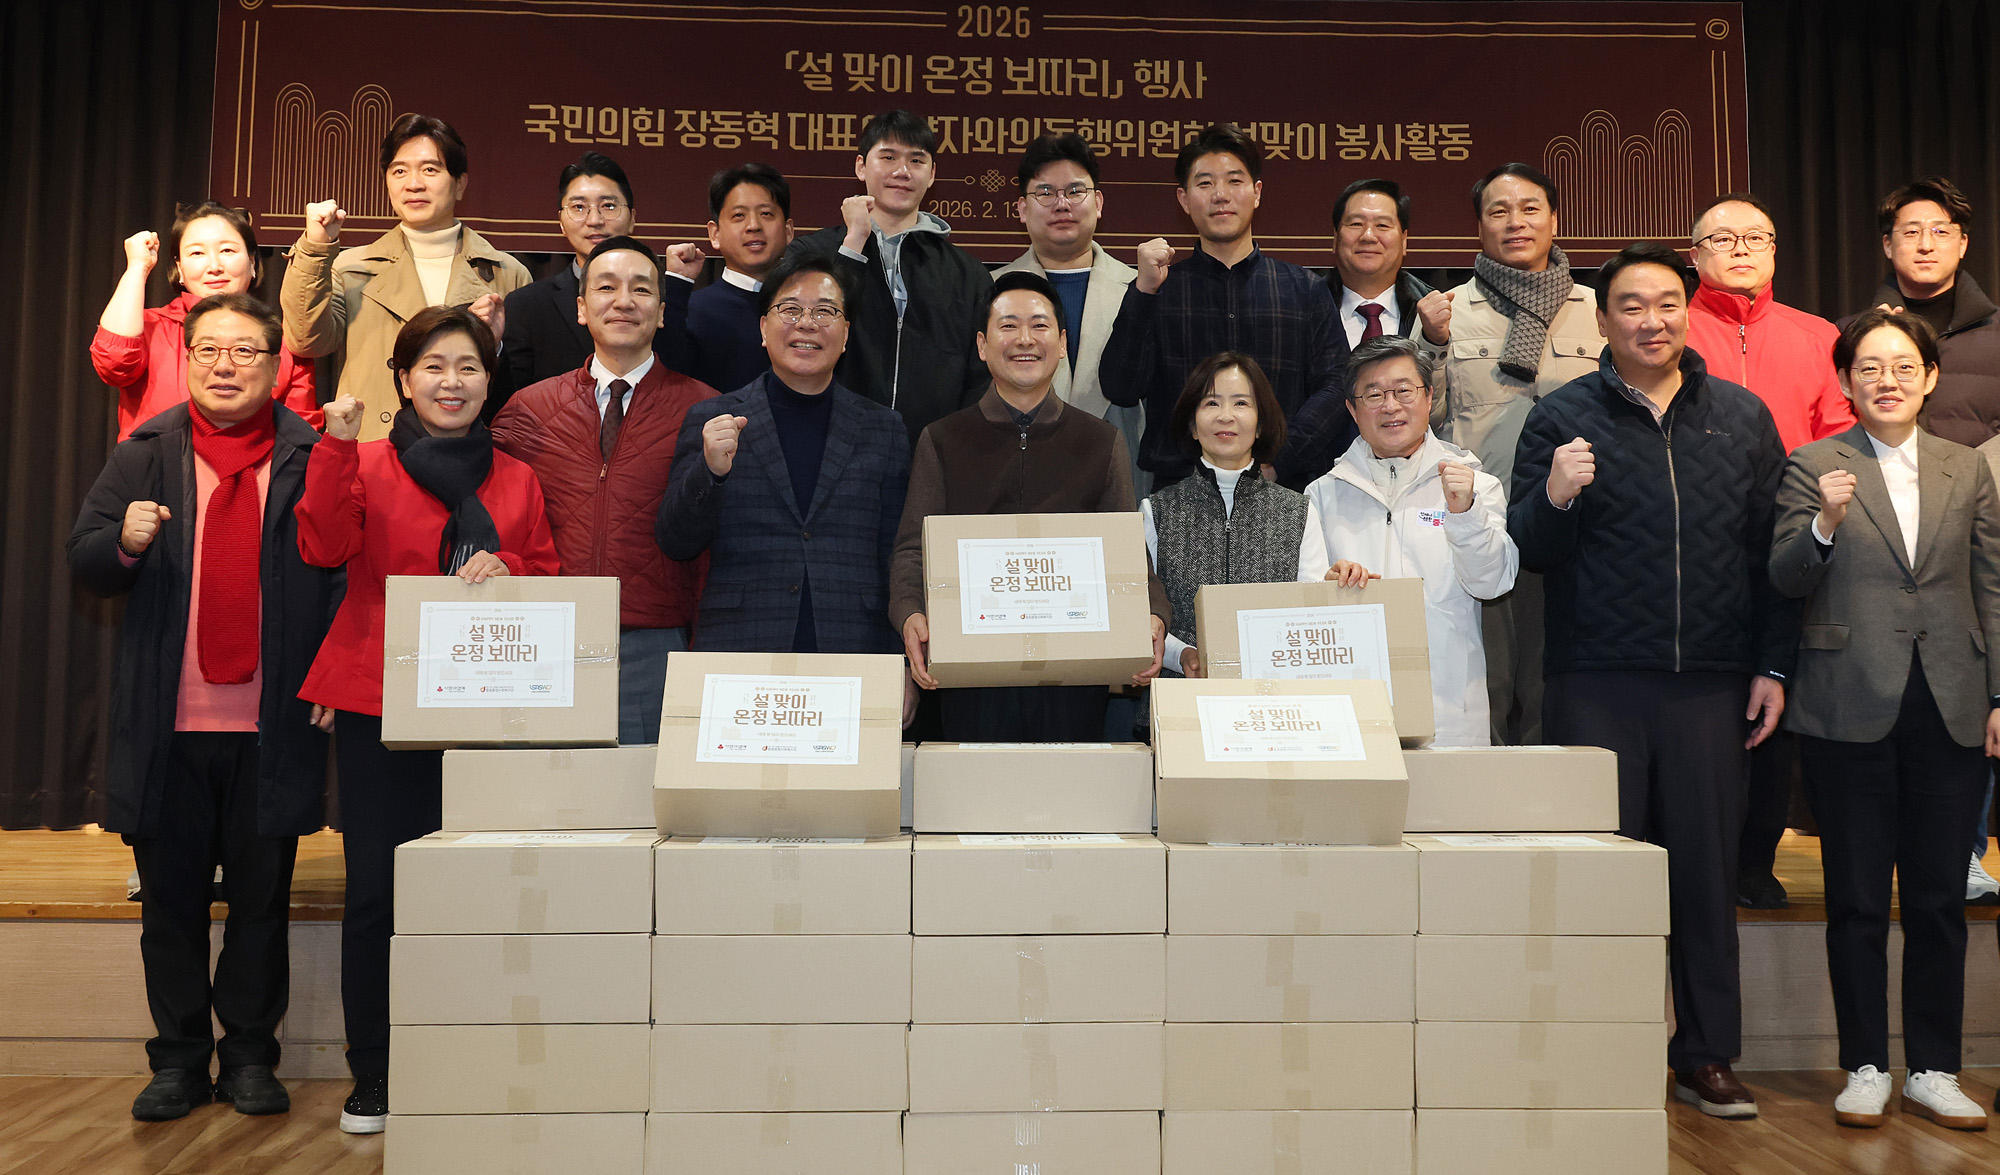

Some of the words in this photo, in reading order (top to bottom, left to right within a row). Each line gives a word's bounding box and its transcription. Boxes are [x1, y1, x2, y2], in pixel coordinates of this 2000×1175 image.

[957, 5, 1031, 38] 2026
[842, 53, 913, 93] 맞이
[922, 55, 994, 95] 온정
[1133, 59, 1208, 99] 행사
[524, 104, 665, 147] 국민의힘
[674, 109, 780, 150] 장동혁
[787, 112, 877, 151] 대표
[1248, 120, 1327, 161] 맞이
[1335, 122, 1473, 161] 봉사활동
[928, 200, 977, 219] 2026.
[982, 201, 998, 219] 2.
[1005, 558, 1020, 575] 설
[1023, 558, 1055, 574] 맞이
[989, 576, 1020, 593] 온정
[1024, 575, 1072, 592] 보따리
[469, 624, 485, 642] 설
[489, 624, 522, 642] 맞이
[1285, 629, 1301, 647] 설
[1304, 628, 1336, 646] 맞이
[450, 644, 484, 662] 온정
[487, 644, 538, 662] 보따리
[1270, 649, 1303, 668] 온정
[1305, 646, 1354, 666] 보따리
[753, 693, 769, 709] 설
[773, 694, 807, 709] 맞이
[733, 710, 768, 725] 온정
[770, 710, 823, 727] 보따리
[1248, 709, 1265, 721] 설
[1267, 708, 1302, 720] 맞이
[1232, 720, 1266, 732] 온정
[1270, 720, 1322, 732] 보따리
